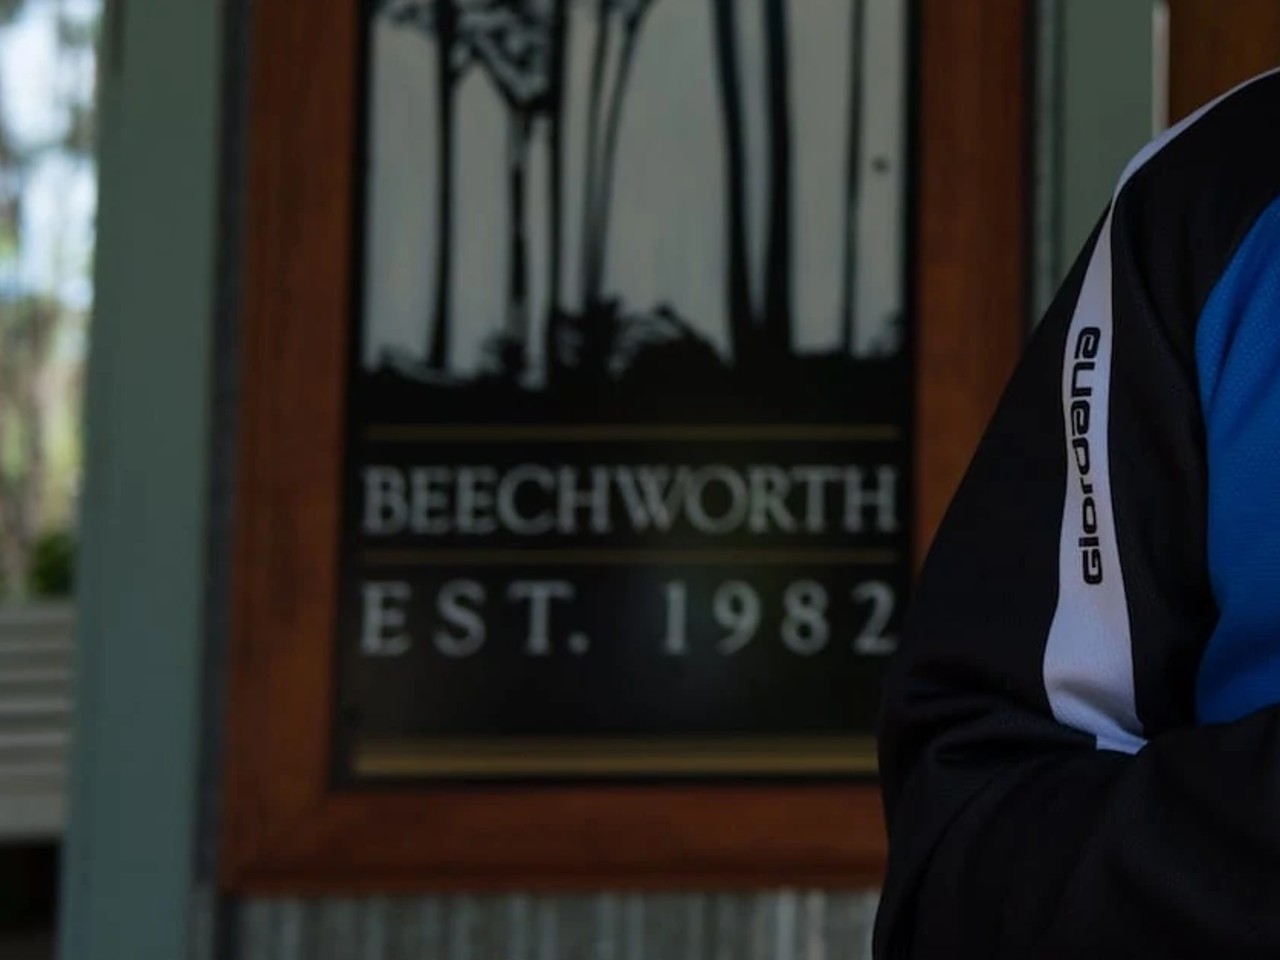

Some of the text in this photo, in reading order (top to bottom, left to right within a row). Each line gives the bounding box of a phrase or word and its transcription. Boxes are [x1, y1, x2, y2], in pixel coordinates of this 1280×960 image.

[1070, 327, 1102, 585] Giordana
[361, 462, 899, 534] BEECHWORTH
[360, 578, 898, 656] EST. 1982
